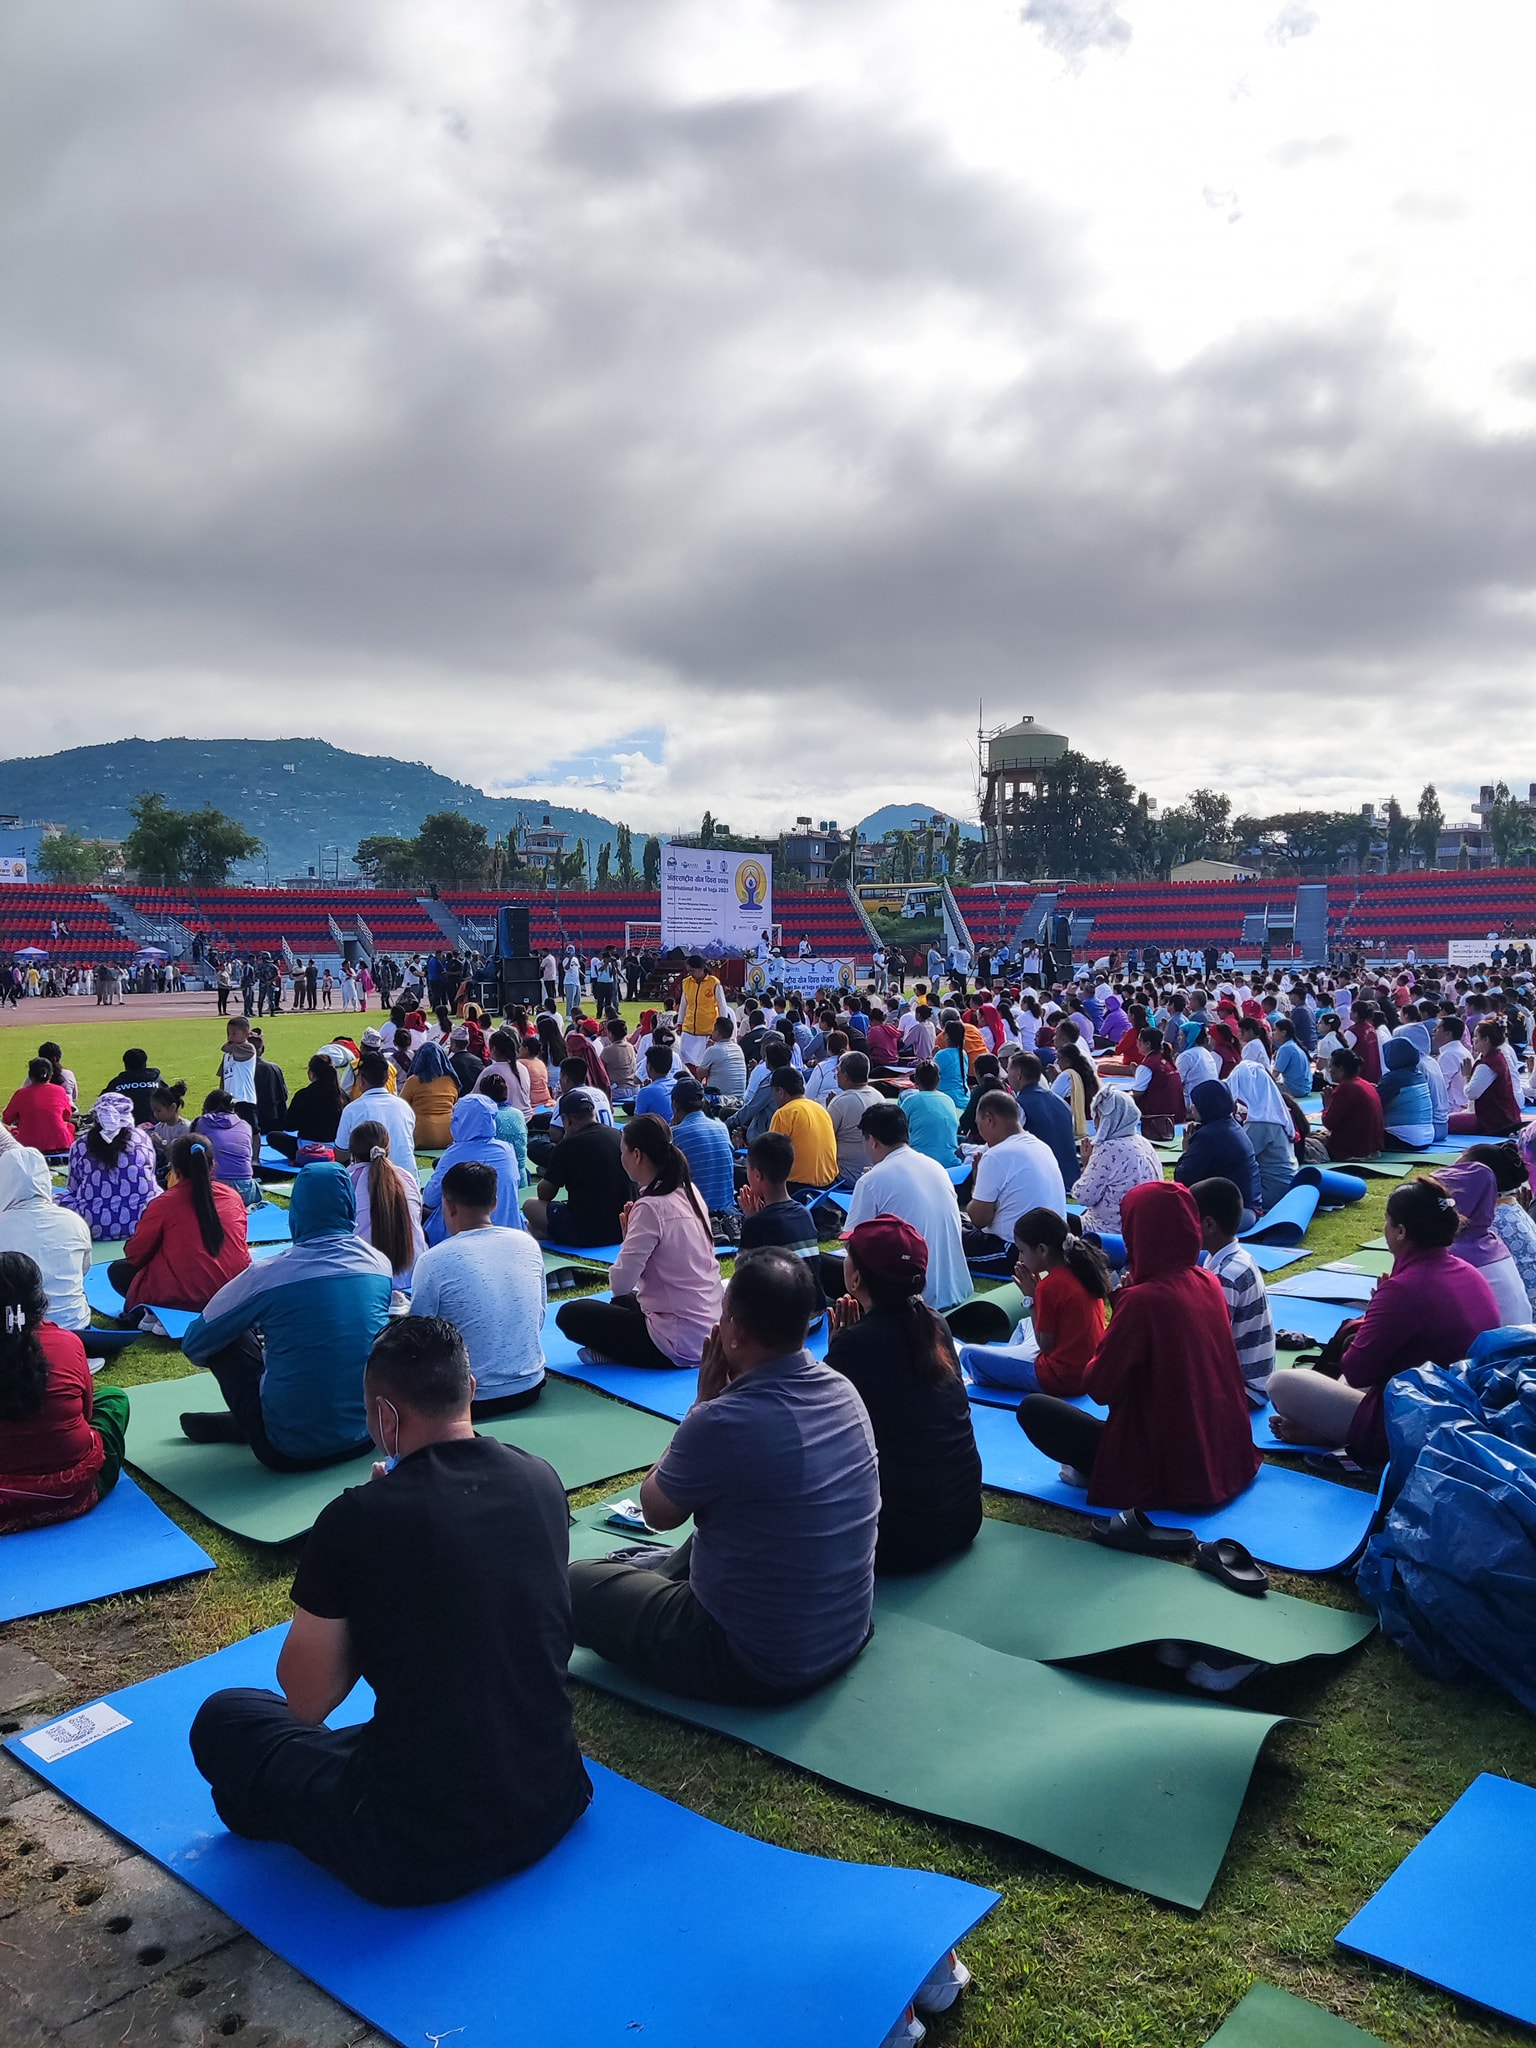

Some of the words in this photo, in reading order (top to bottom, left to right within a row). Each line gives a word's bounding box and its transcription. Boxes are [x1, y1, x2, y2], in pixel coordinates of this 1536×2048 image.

[115, 1081, 159, 1092] SWOOSH
[46, 1743, 79, 1761] UNILEVER
[80, 1733, 103, 1747] NEPAL
[102, 1719, 129, 1734] LIMITED
